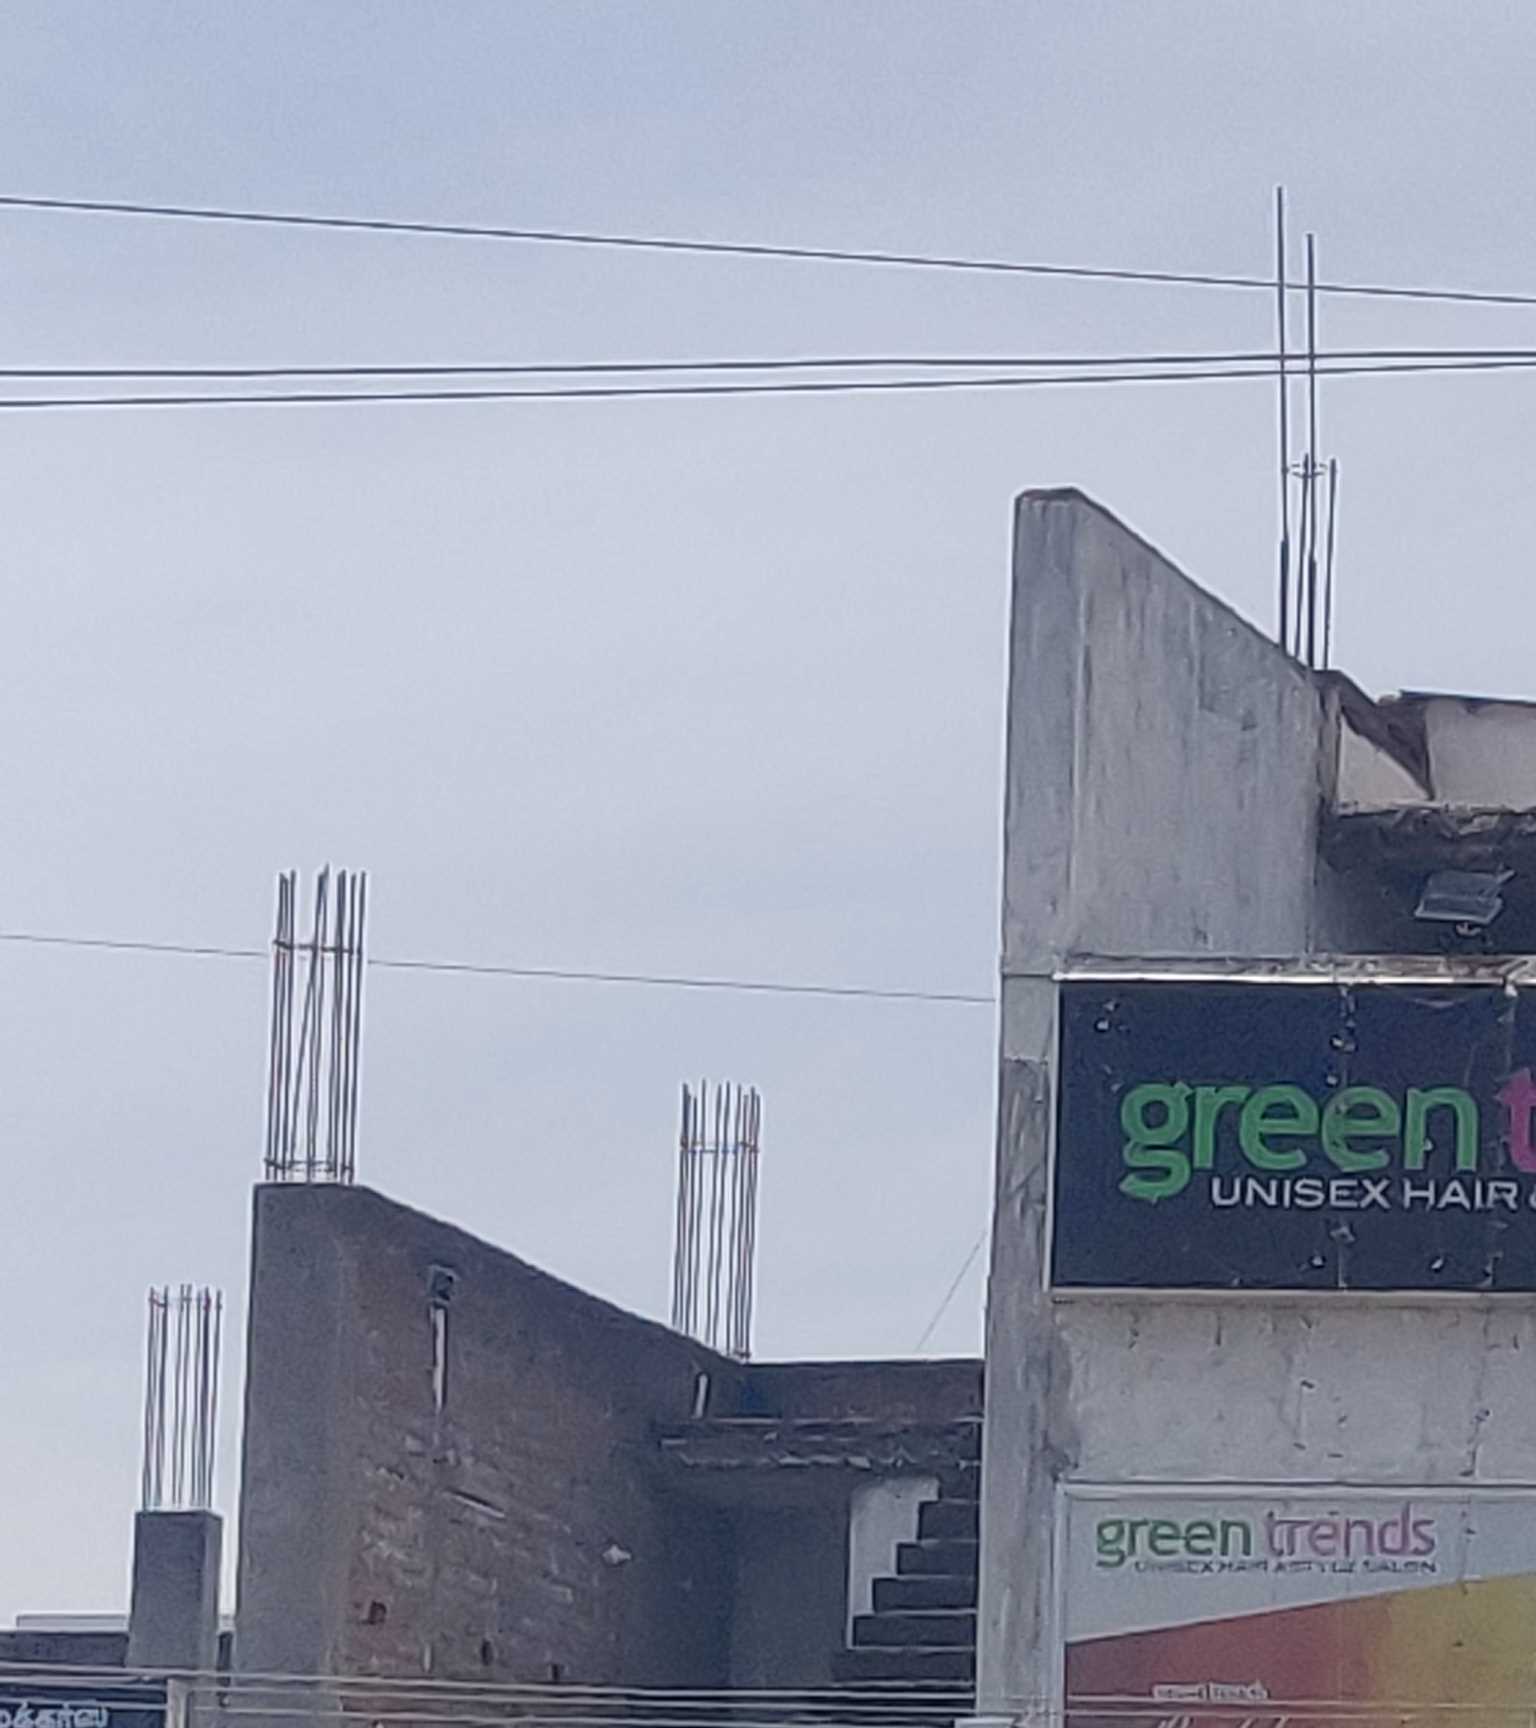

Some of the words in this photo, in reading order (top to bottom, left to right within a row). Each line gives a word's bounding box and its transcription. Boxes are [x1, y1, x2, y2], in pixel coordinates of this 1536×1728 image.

[1119, 1080, 1479, 1200] green
[1210, 1177, 1392, 1211] UNISEX
[1402, 1180, 1519, 1212] HAIR
[1096, 1516, 1252, 1569] green
[1265, 1502, 1438, 1558] trends
